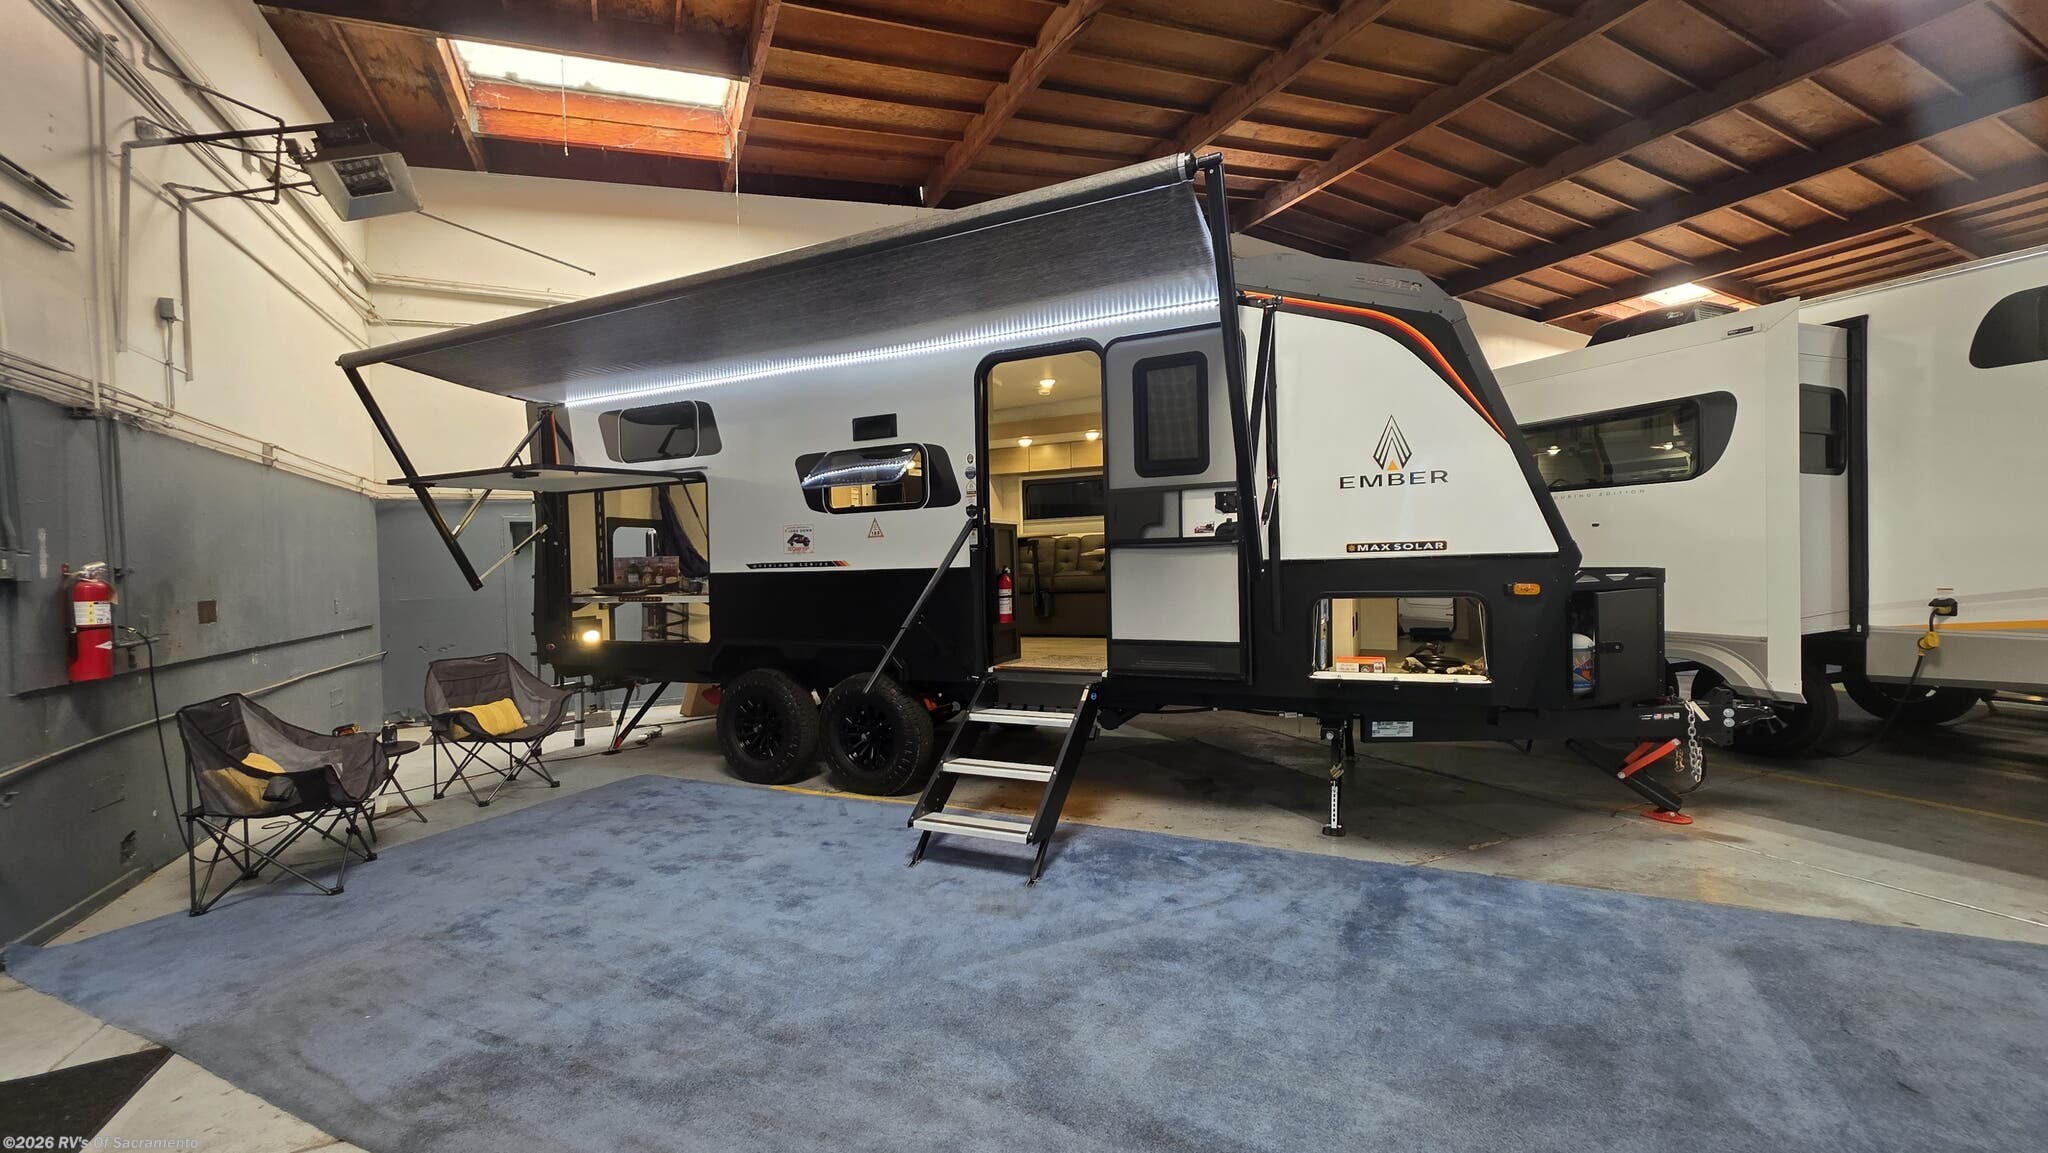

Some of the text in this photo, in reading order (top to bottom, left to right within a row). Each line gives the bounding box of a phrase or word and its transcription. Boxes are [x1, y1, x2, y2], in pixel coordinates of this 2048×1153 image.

[1339, 470, 1449, 490] EMBER
[1357, 542, 1445, 552] MAX SOLAR
